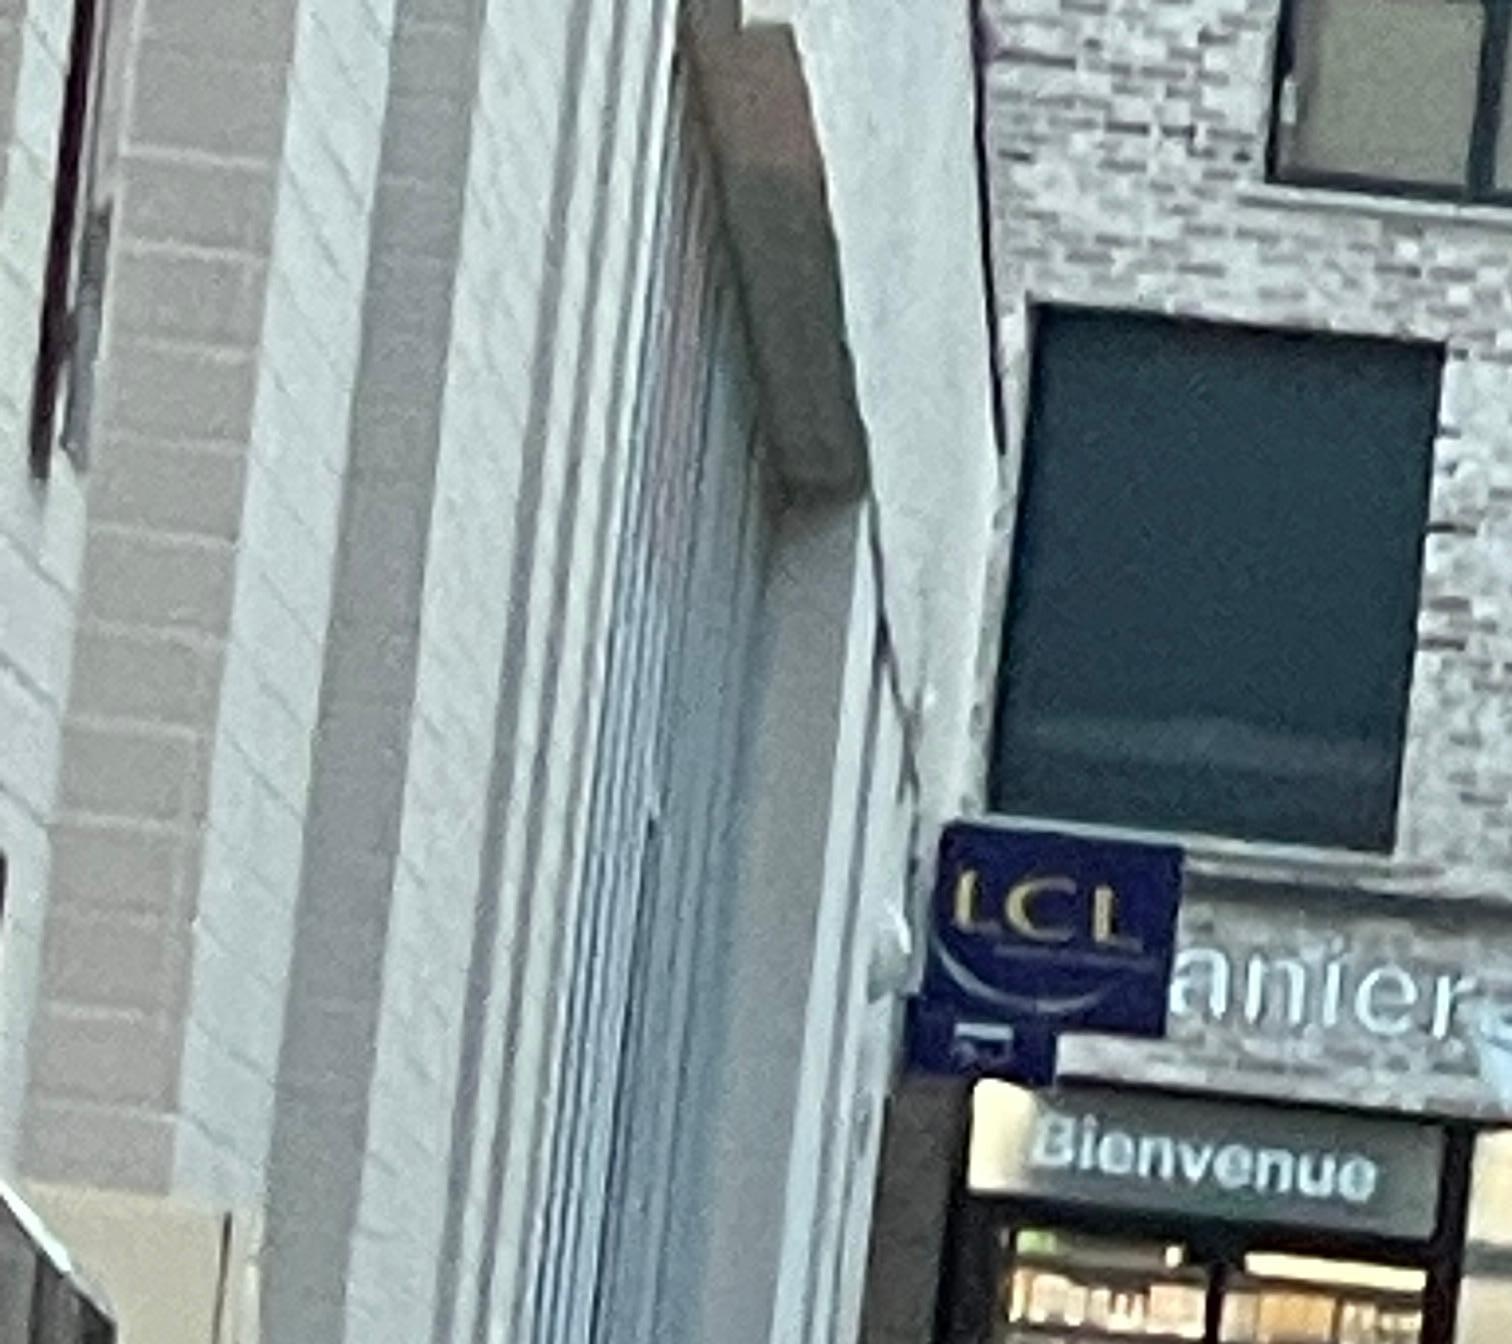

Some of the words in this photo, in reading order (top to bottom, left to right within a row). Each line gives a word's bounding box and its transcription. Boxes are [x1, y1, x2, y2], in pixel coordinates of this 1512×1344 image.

[951, 868, 1145, 954] LCL
[1168, 937, 1473, 1041] anier
[1031, 1114, 1379, 1202] Bienvenue
